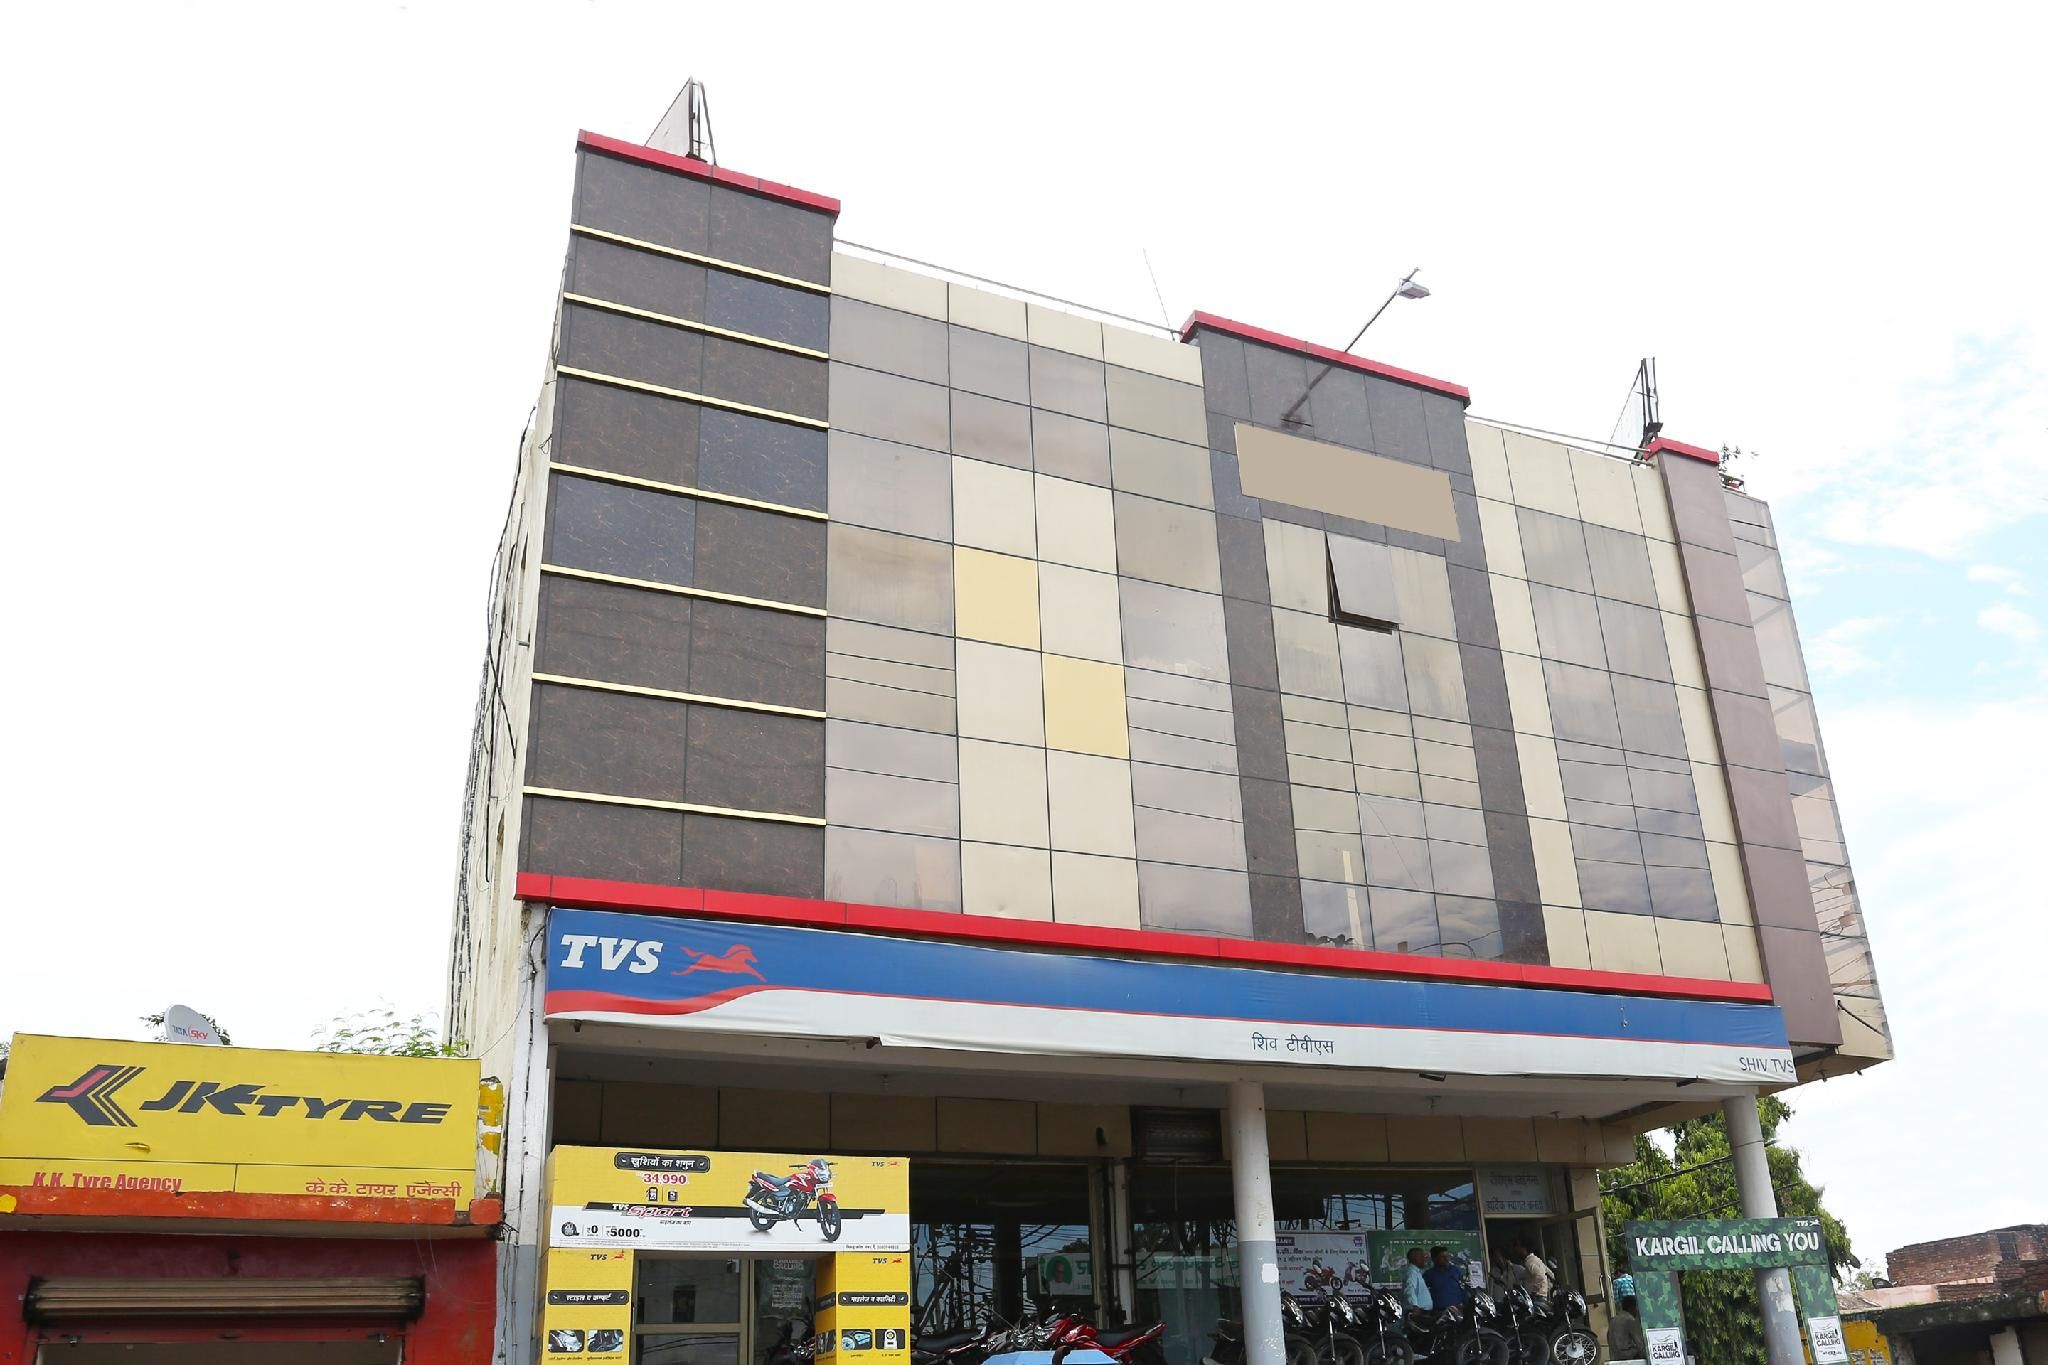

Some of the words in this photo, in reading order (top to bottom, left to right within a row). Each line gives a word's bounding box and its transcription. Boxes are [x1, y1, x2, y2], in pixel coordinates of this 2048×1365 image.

[560, 934, 664, 974] TVS
[1252, 1032, 1278, 1051] शिव
[1285, 1034, 1334, 1055] टीवीएस
[1739, 1057, 1767, 1071] SHIV
[1771, 1059, 1794, 1073] TVS
[33, 1172, 66, 1187] K.K.
[72, 1173, 112, 1188] Tyre
[114, 1174, 182, 1193] Agency
[356, 1183, 398, 1195] टायर
[627, 1205, 693, 1218] Sport
[1635, 1236, 1704, 1256] KARGIL
[1707, 1233, 1781, 1253] CALLING
[1783, 1232, 1819, 1251] YOU
[1653, 1343, 1677, 1352] KARGIL
[1653, 1351, 1680, 1359] CALLING
